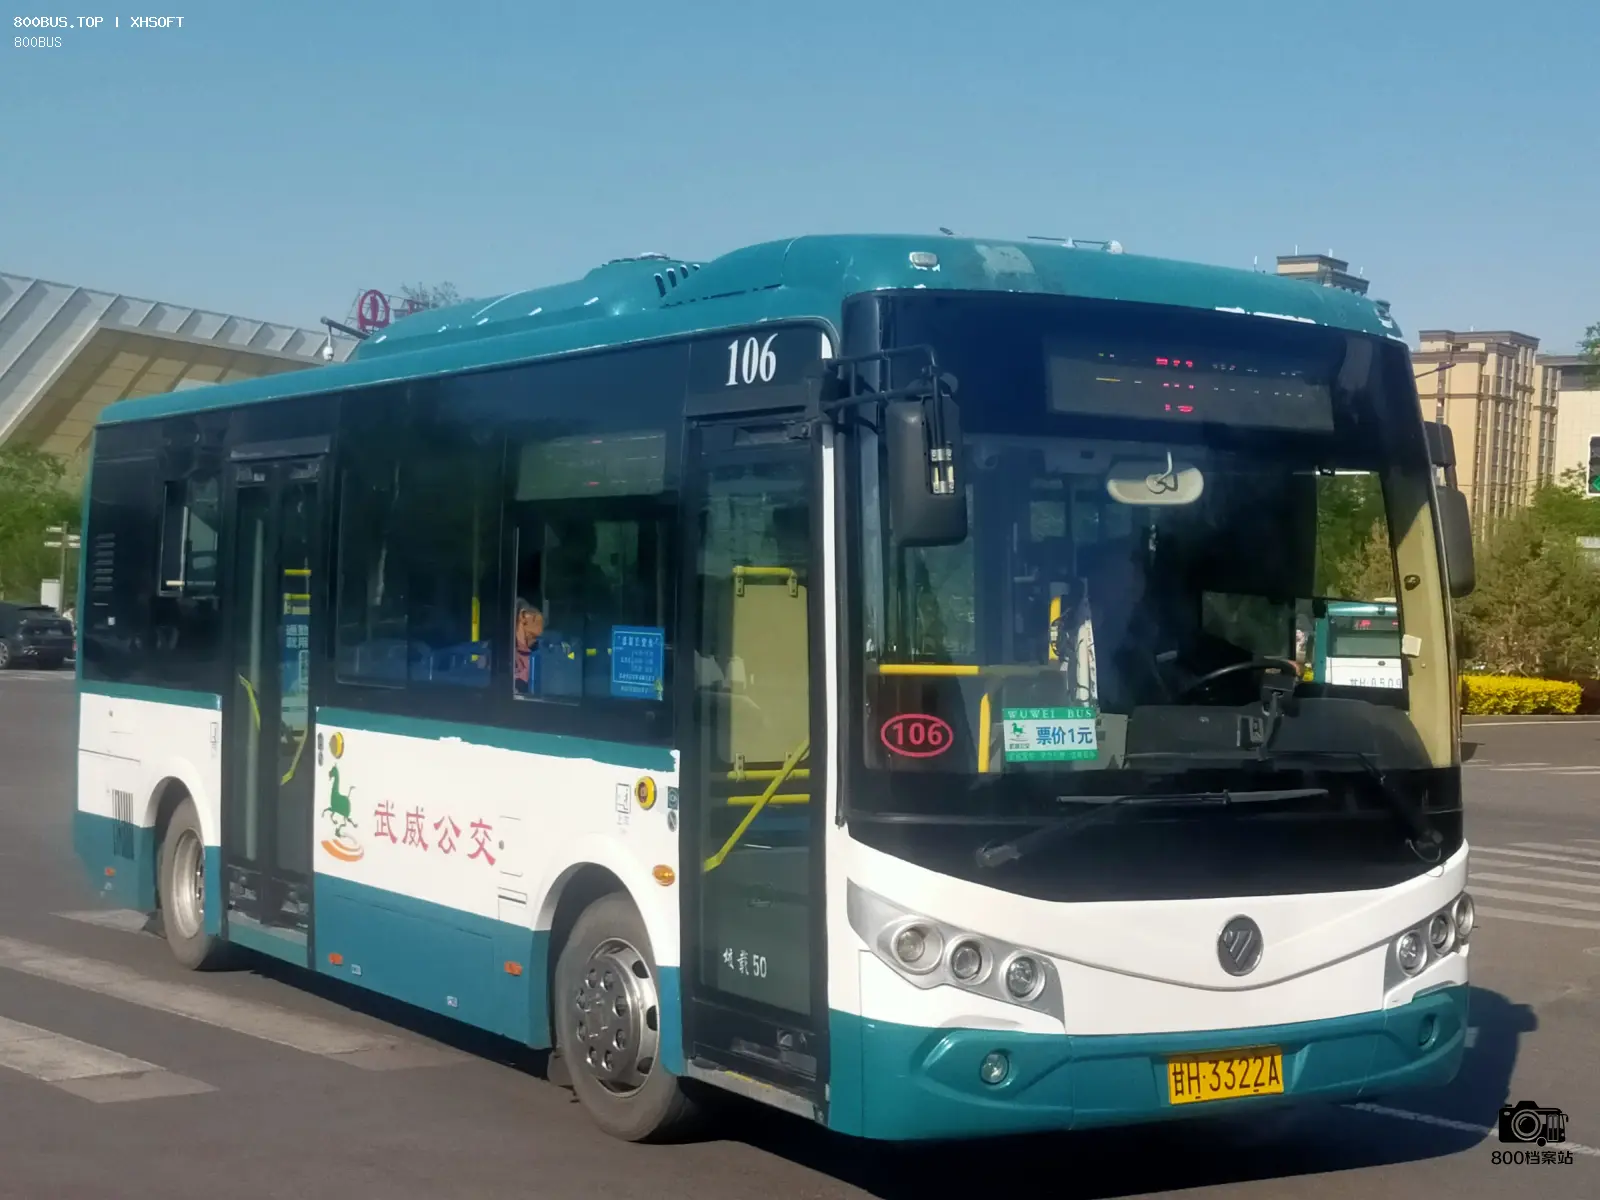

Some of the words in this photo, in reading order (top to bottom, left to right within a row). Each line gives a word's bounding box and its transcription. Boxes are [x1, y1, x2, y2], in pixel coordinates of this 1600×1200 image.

[725, 332, 778, 386] 106
[1007, 709, 1056, 719] WUWEI
[1067, 708, 1093, 719] BUS
[891, 722, 944, 746] 106
[1035, 725, 1093, 746] 票价1元
[373, 799, 497, 866] 武威公交
